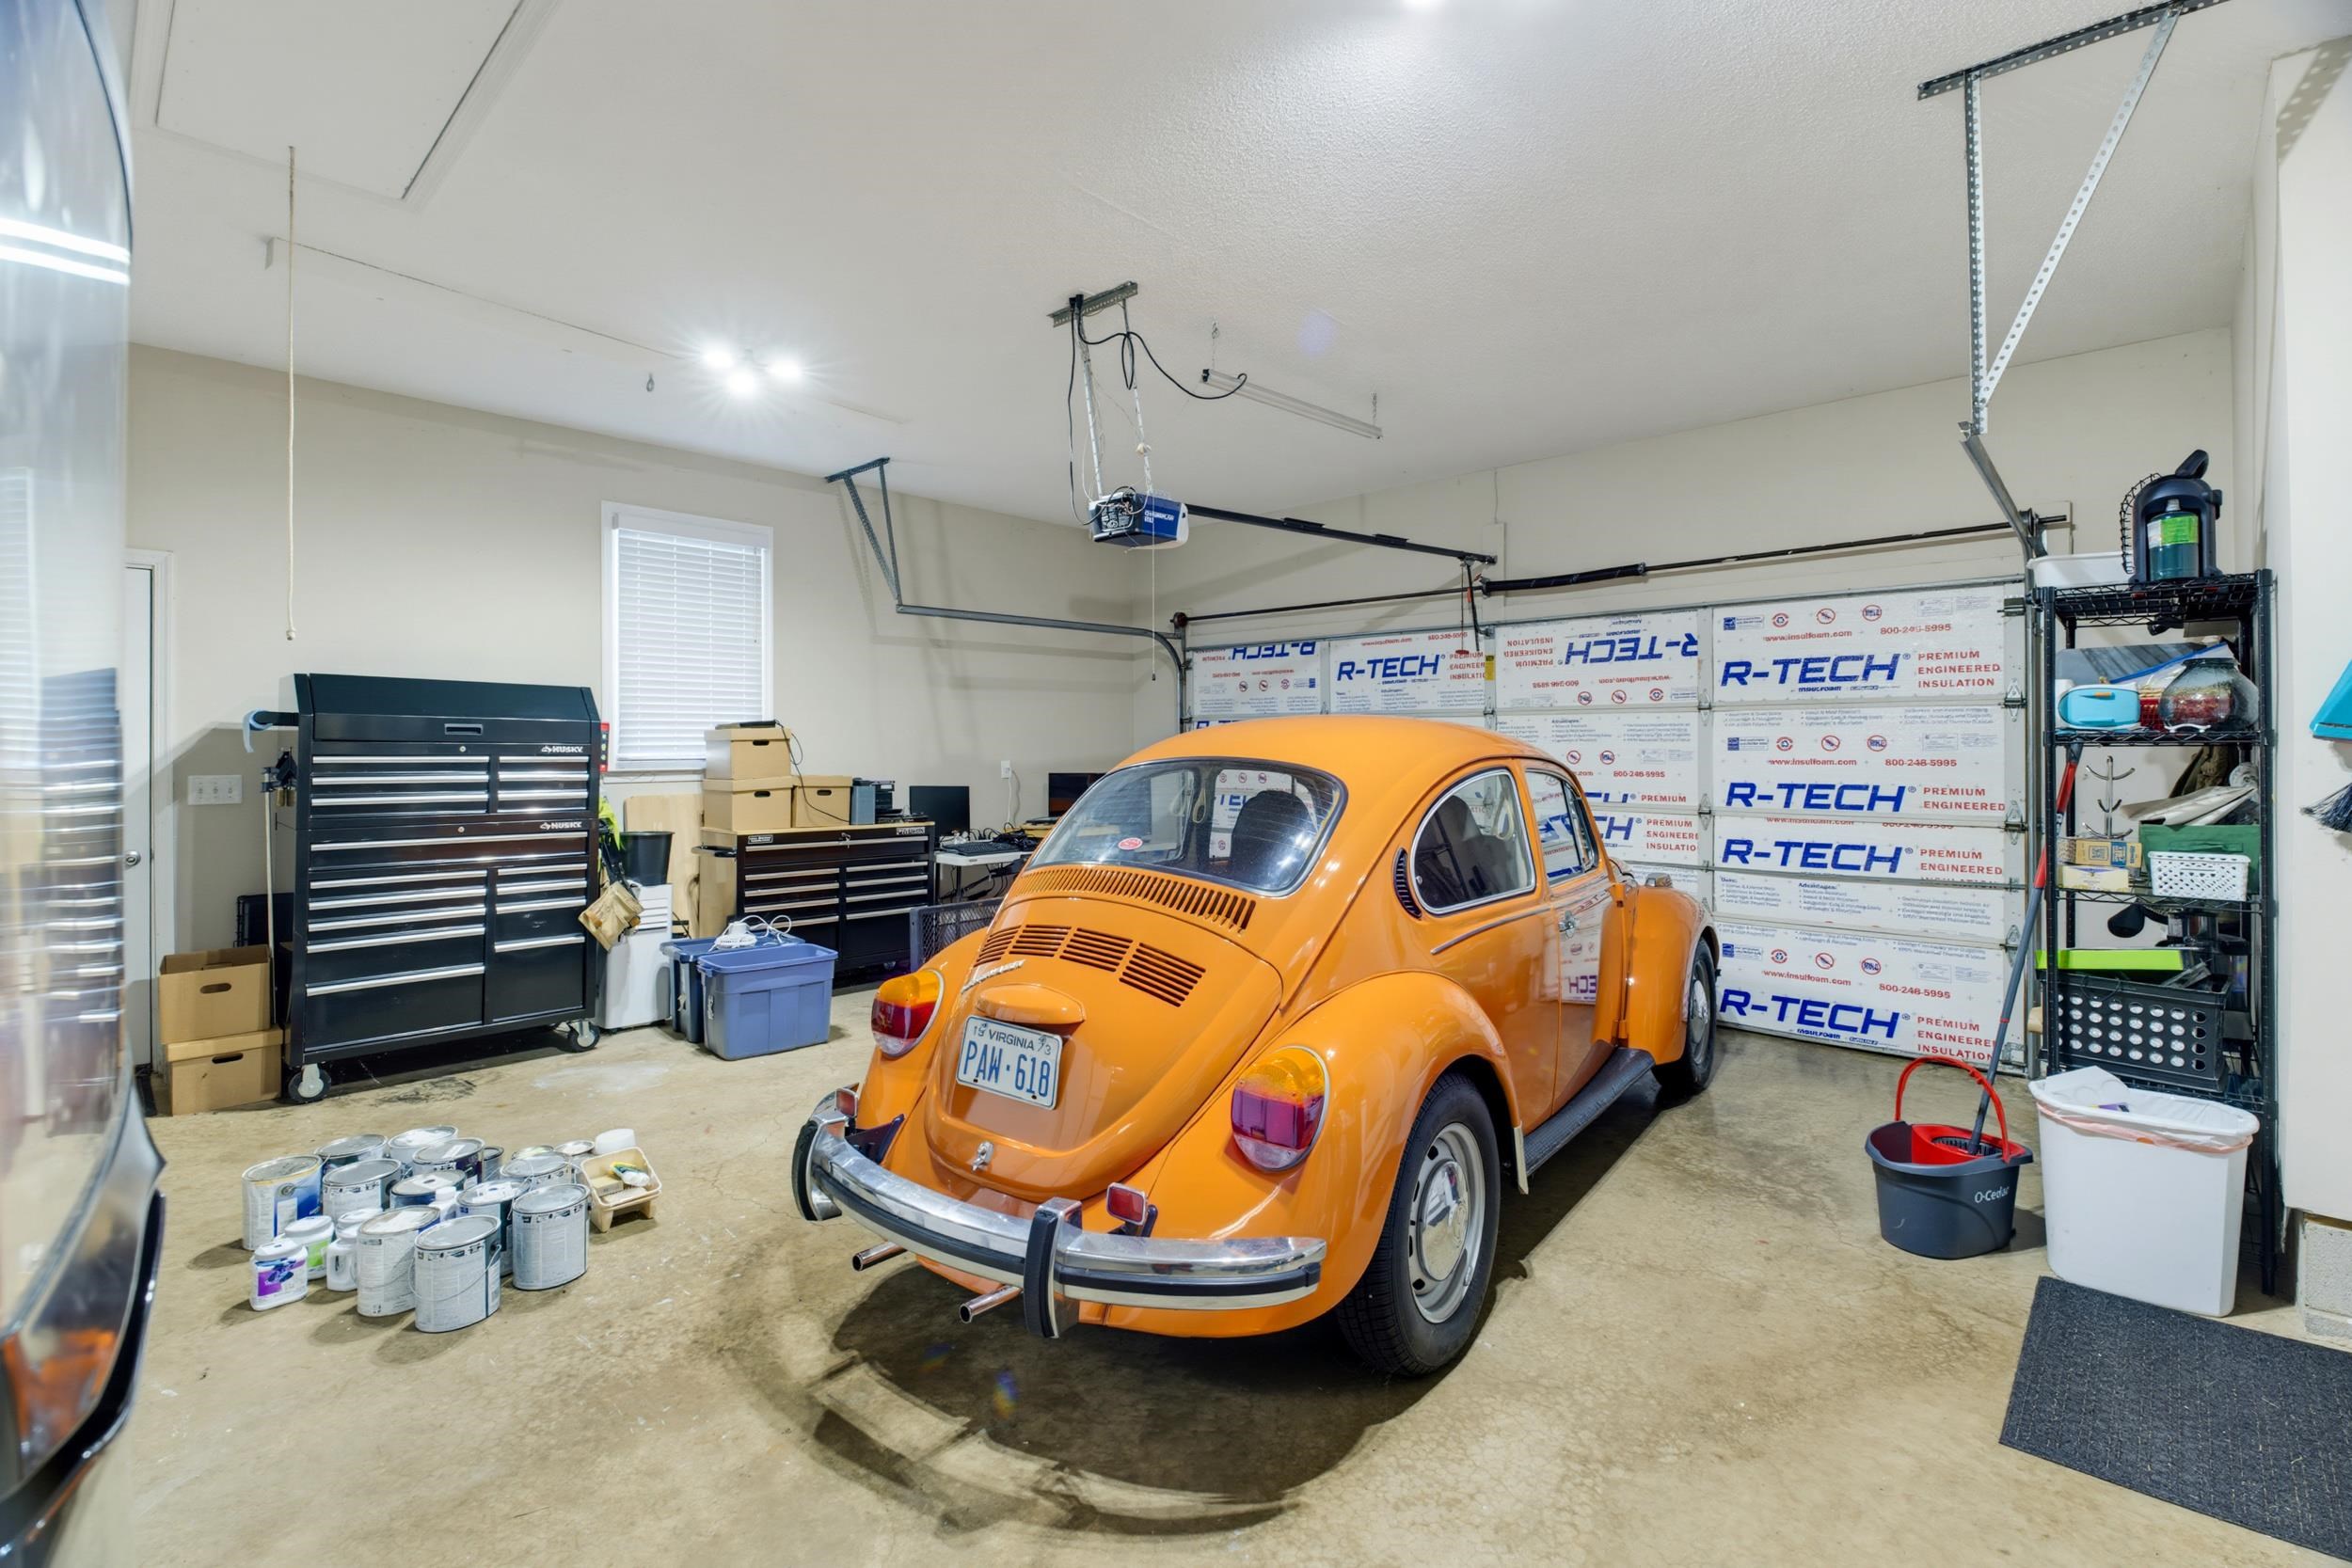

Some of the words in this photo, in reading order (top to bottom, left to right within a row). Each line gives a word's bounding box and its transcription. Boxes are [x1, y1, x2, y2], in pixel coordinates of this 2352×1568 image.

[1917, 650, 1980, 660] PREMIUM
[1516, 658, 1553, 668] PREMIUM
[1917, 663, 2000, 674] ENGINEERED
[1918, 678, 1995, 689] INSULATION
[1768, 757, 1857, 767] www.insulfoam.com
[1923, 786, 1986, 797] PREMIUM
[1641, 794, 1687, 803] PREMIUM
[1923, 800, 2006, 812] ENGINEERED
[1646, 818, 1692, 828] PREMIUM
[1646, 843, 1697, 852] INSULATIO
[1919, 848, 1983, 860] PREMIUM
[1919, 863, 2003, 875] ENGINEERED
[1763, 969, 1852, 986] www.insulfoam.com
[1917, 1017, 1980, 1032] PREMIUM
[989, 1029, 1034, 1051] VIRGINIA
